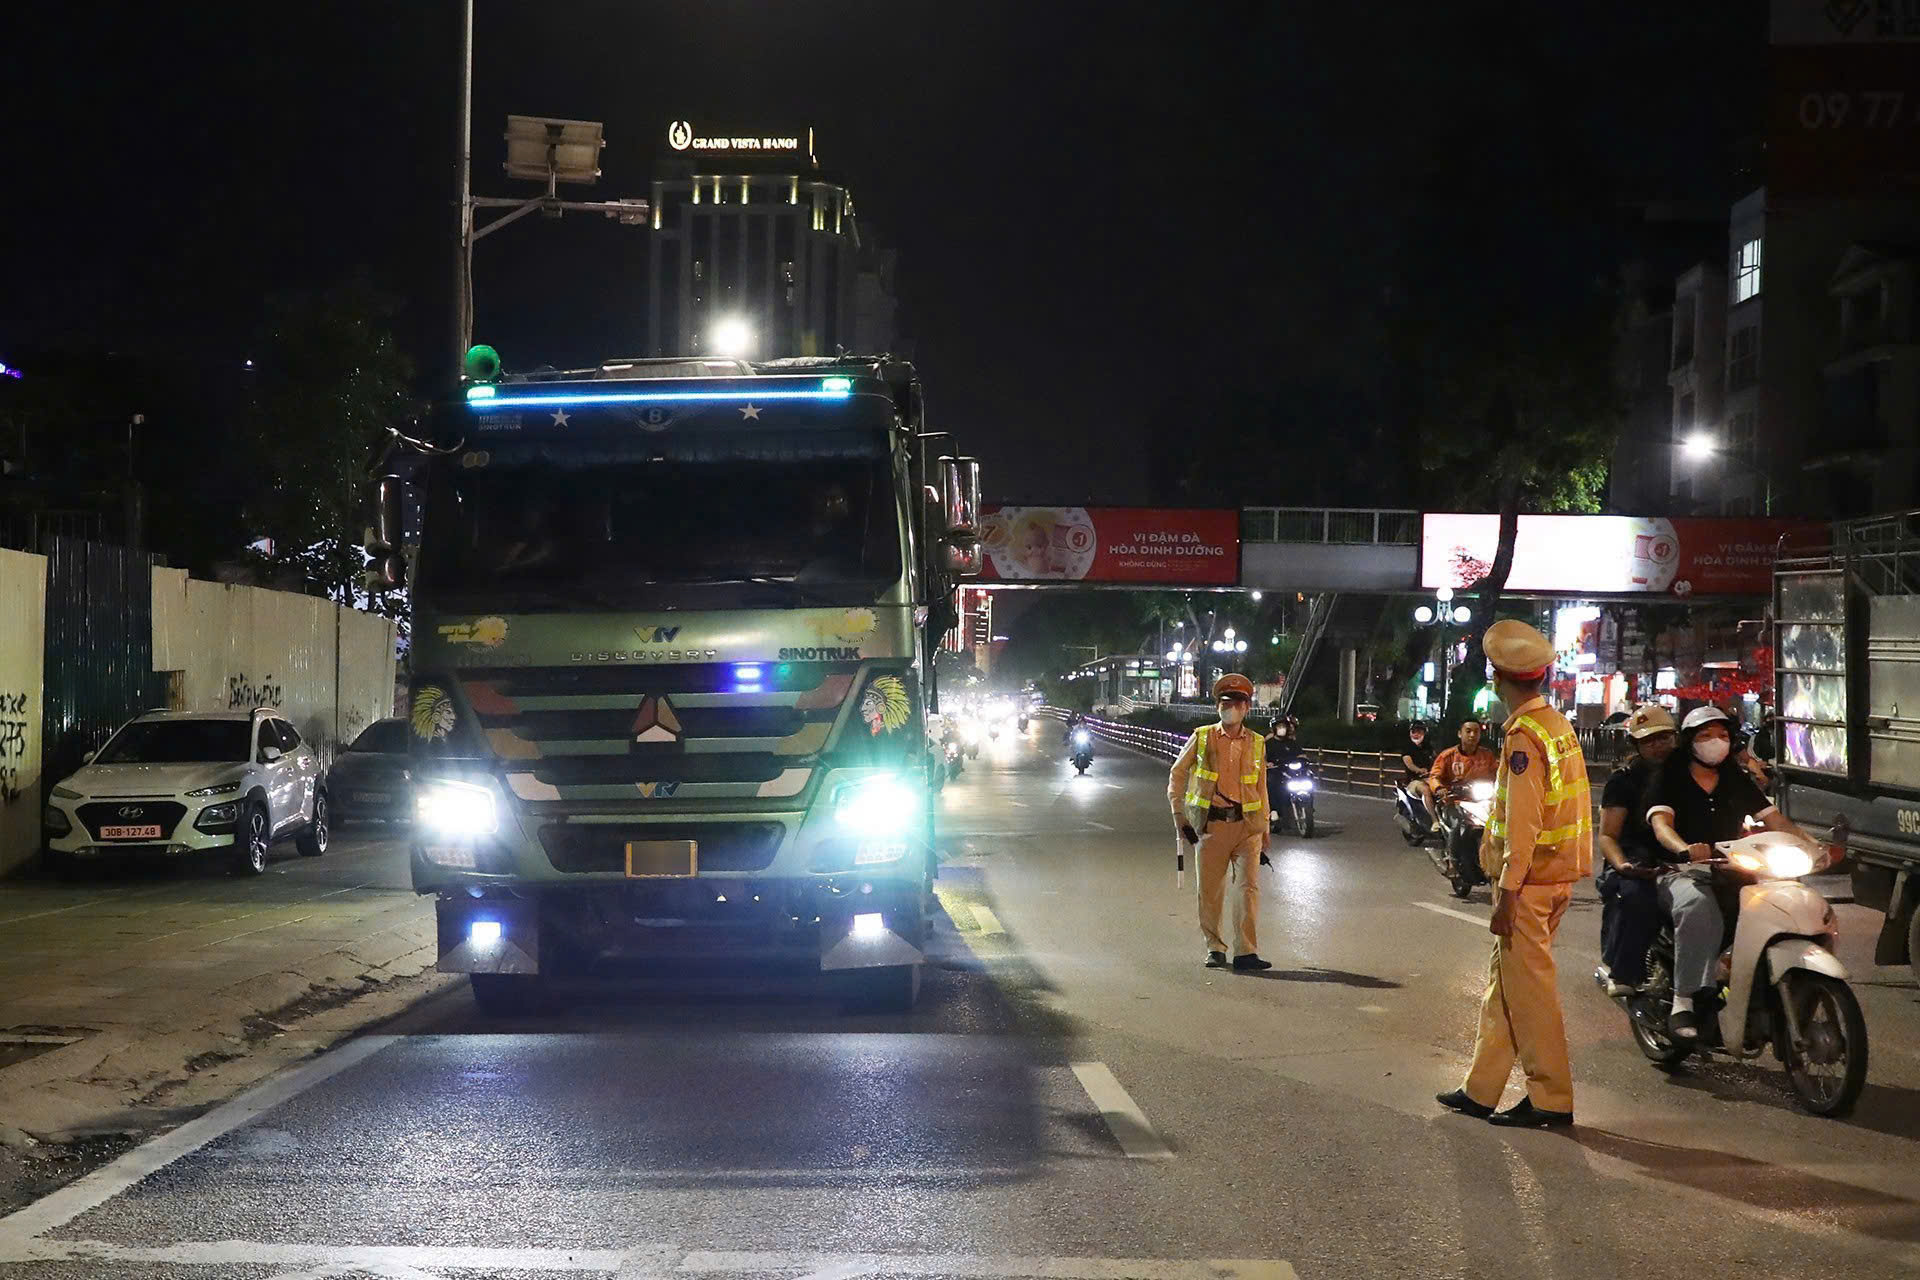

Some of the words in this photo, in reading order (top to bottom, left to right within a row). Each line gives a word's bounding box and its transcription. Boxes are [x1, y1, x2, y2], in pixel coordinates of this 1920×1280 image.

[1800, 92, 1849, 129] 09
[692, 138, 729, 149] GRAND
[731, 138, 760, 149] VISTA
[763, 138, 798, 149] HANOI
[1133, 532, 1146, 545] VỊ
[1149, 531, 1178, 545] ĐẬM
[1182, 530, 1201, 543] ĐÀ
[1109, 543, 1137, 555] HÒA
[1140, 545, 1172, 555] DINH
[1176, 544, 1224, 556] DƯỠNG
[778, 647, 861, 661] SINOTRUK
[105, 827, 156, 837] 30B-127.48
